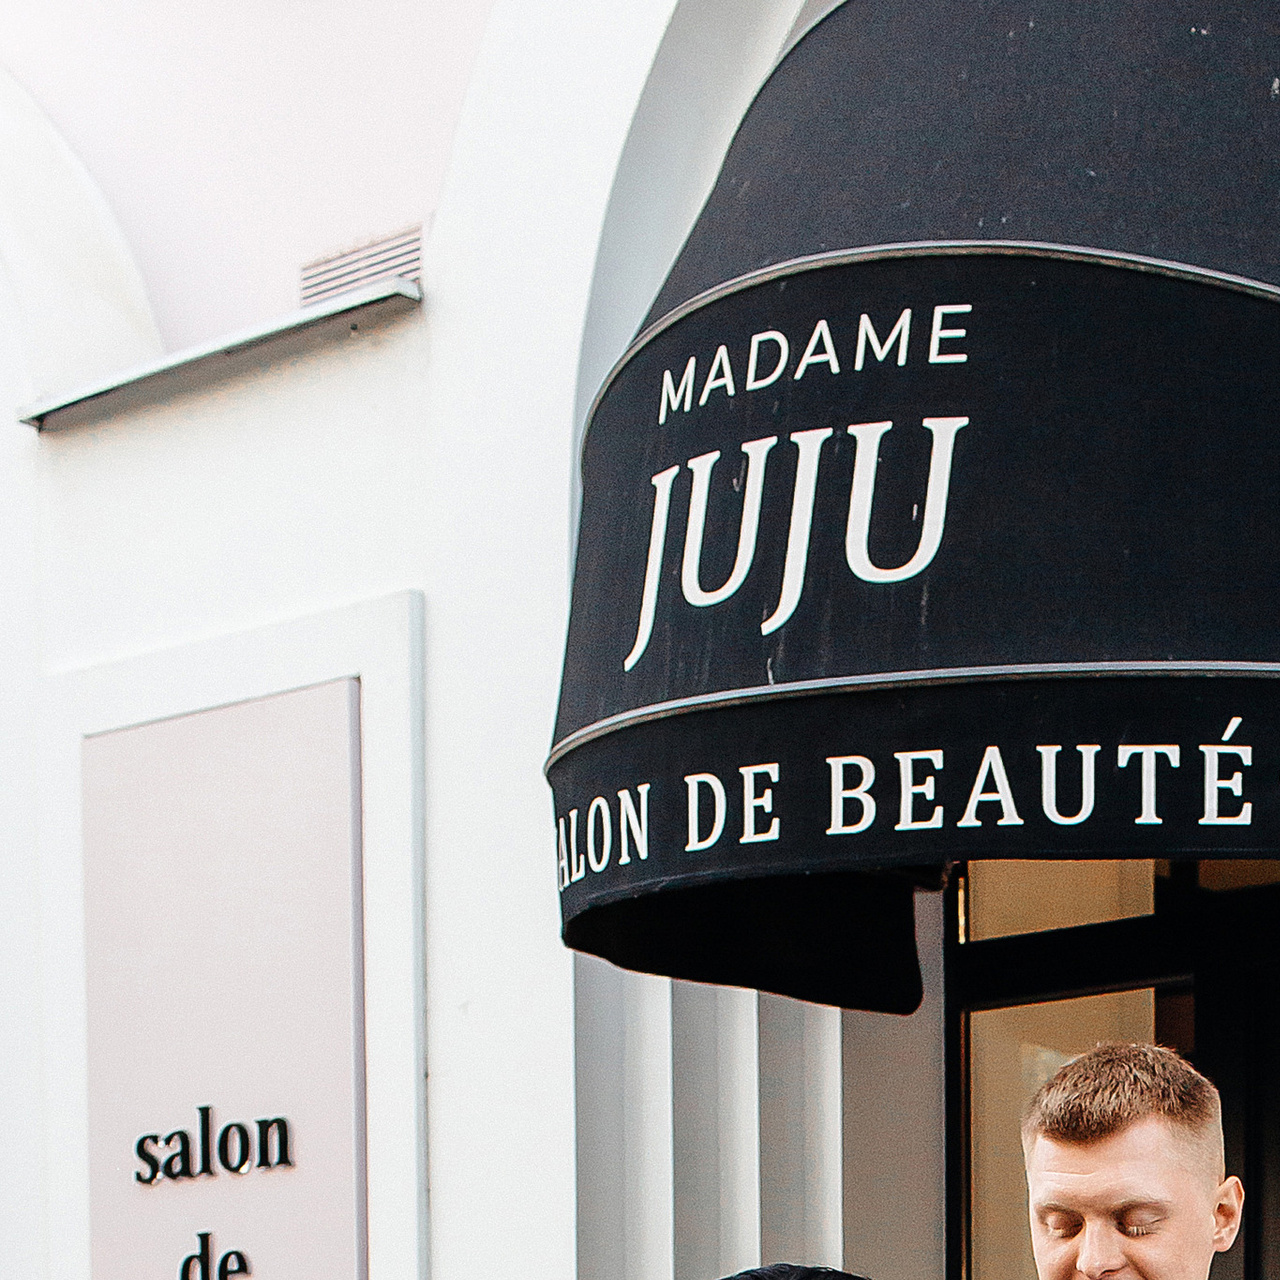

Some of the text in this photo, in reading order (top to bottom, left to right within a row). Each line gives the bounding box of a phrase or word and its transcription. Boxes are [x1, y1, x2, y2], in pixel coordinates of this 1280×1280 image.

[657, 303, 974, 426] MADAME
[622, 415, 971, 673] JUJU
[682, 761, 781, 853] DE
[824, 715, 1254, 837] BEAUTÉ
[134, 1105, 294, 1187] salon
